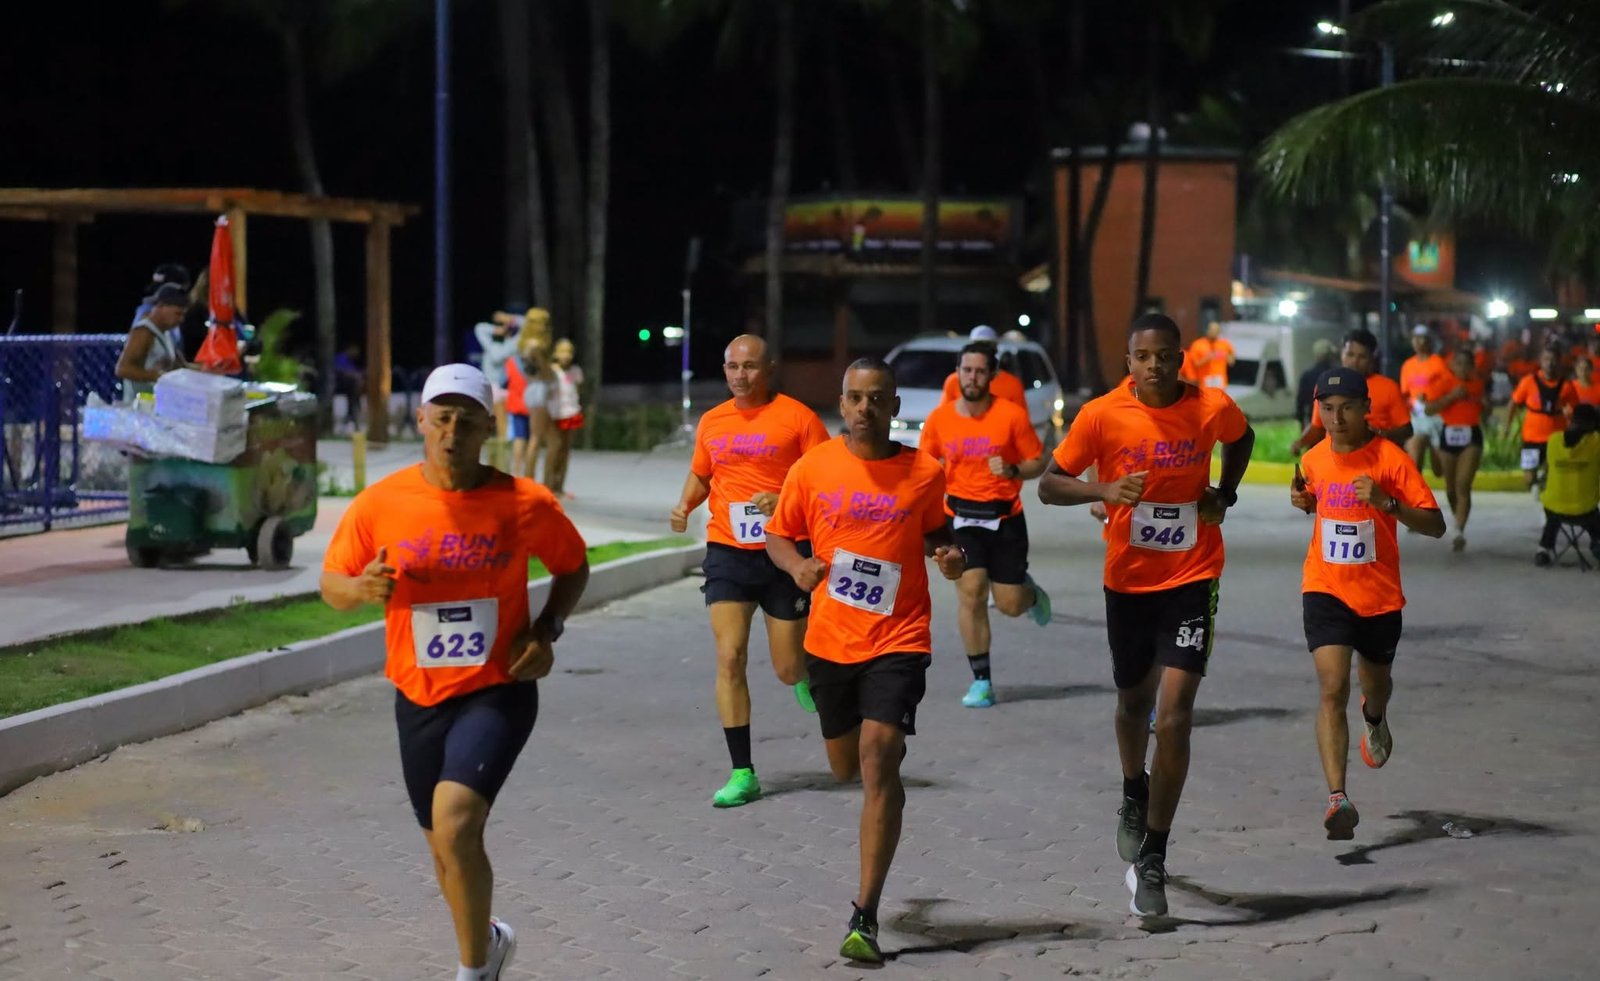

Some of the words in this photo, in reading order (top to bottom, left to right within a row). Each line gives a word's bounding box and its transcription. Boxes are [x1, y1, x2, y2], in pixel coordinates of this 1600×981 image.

[732, 433, 767, 445] RUN
[1154, 440, 1196, 455] RUN
[1153, 451, 1207, 469] NIGHT
[851, 491, 898, 507] RUN
[849, 506, 912, 523] NIGHT
[740, 521, 766, 538] 16
[1140, 525, 1185, 545] 946
[440, 533, 498, 551] RUN
[1329, 541, 1366, 558] 110
[440, 550, 514, 570] NIGHT
[835, 576, 884, 605] 238
[427, 632, 485, 658] 623
[1176, 626, 1205, 651] 34
